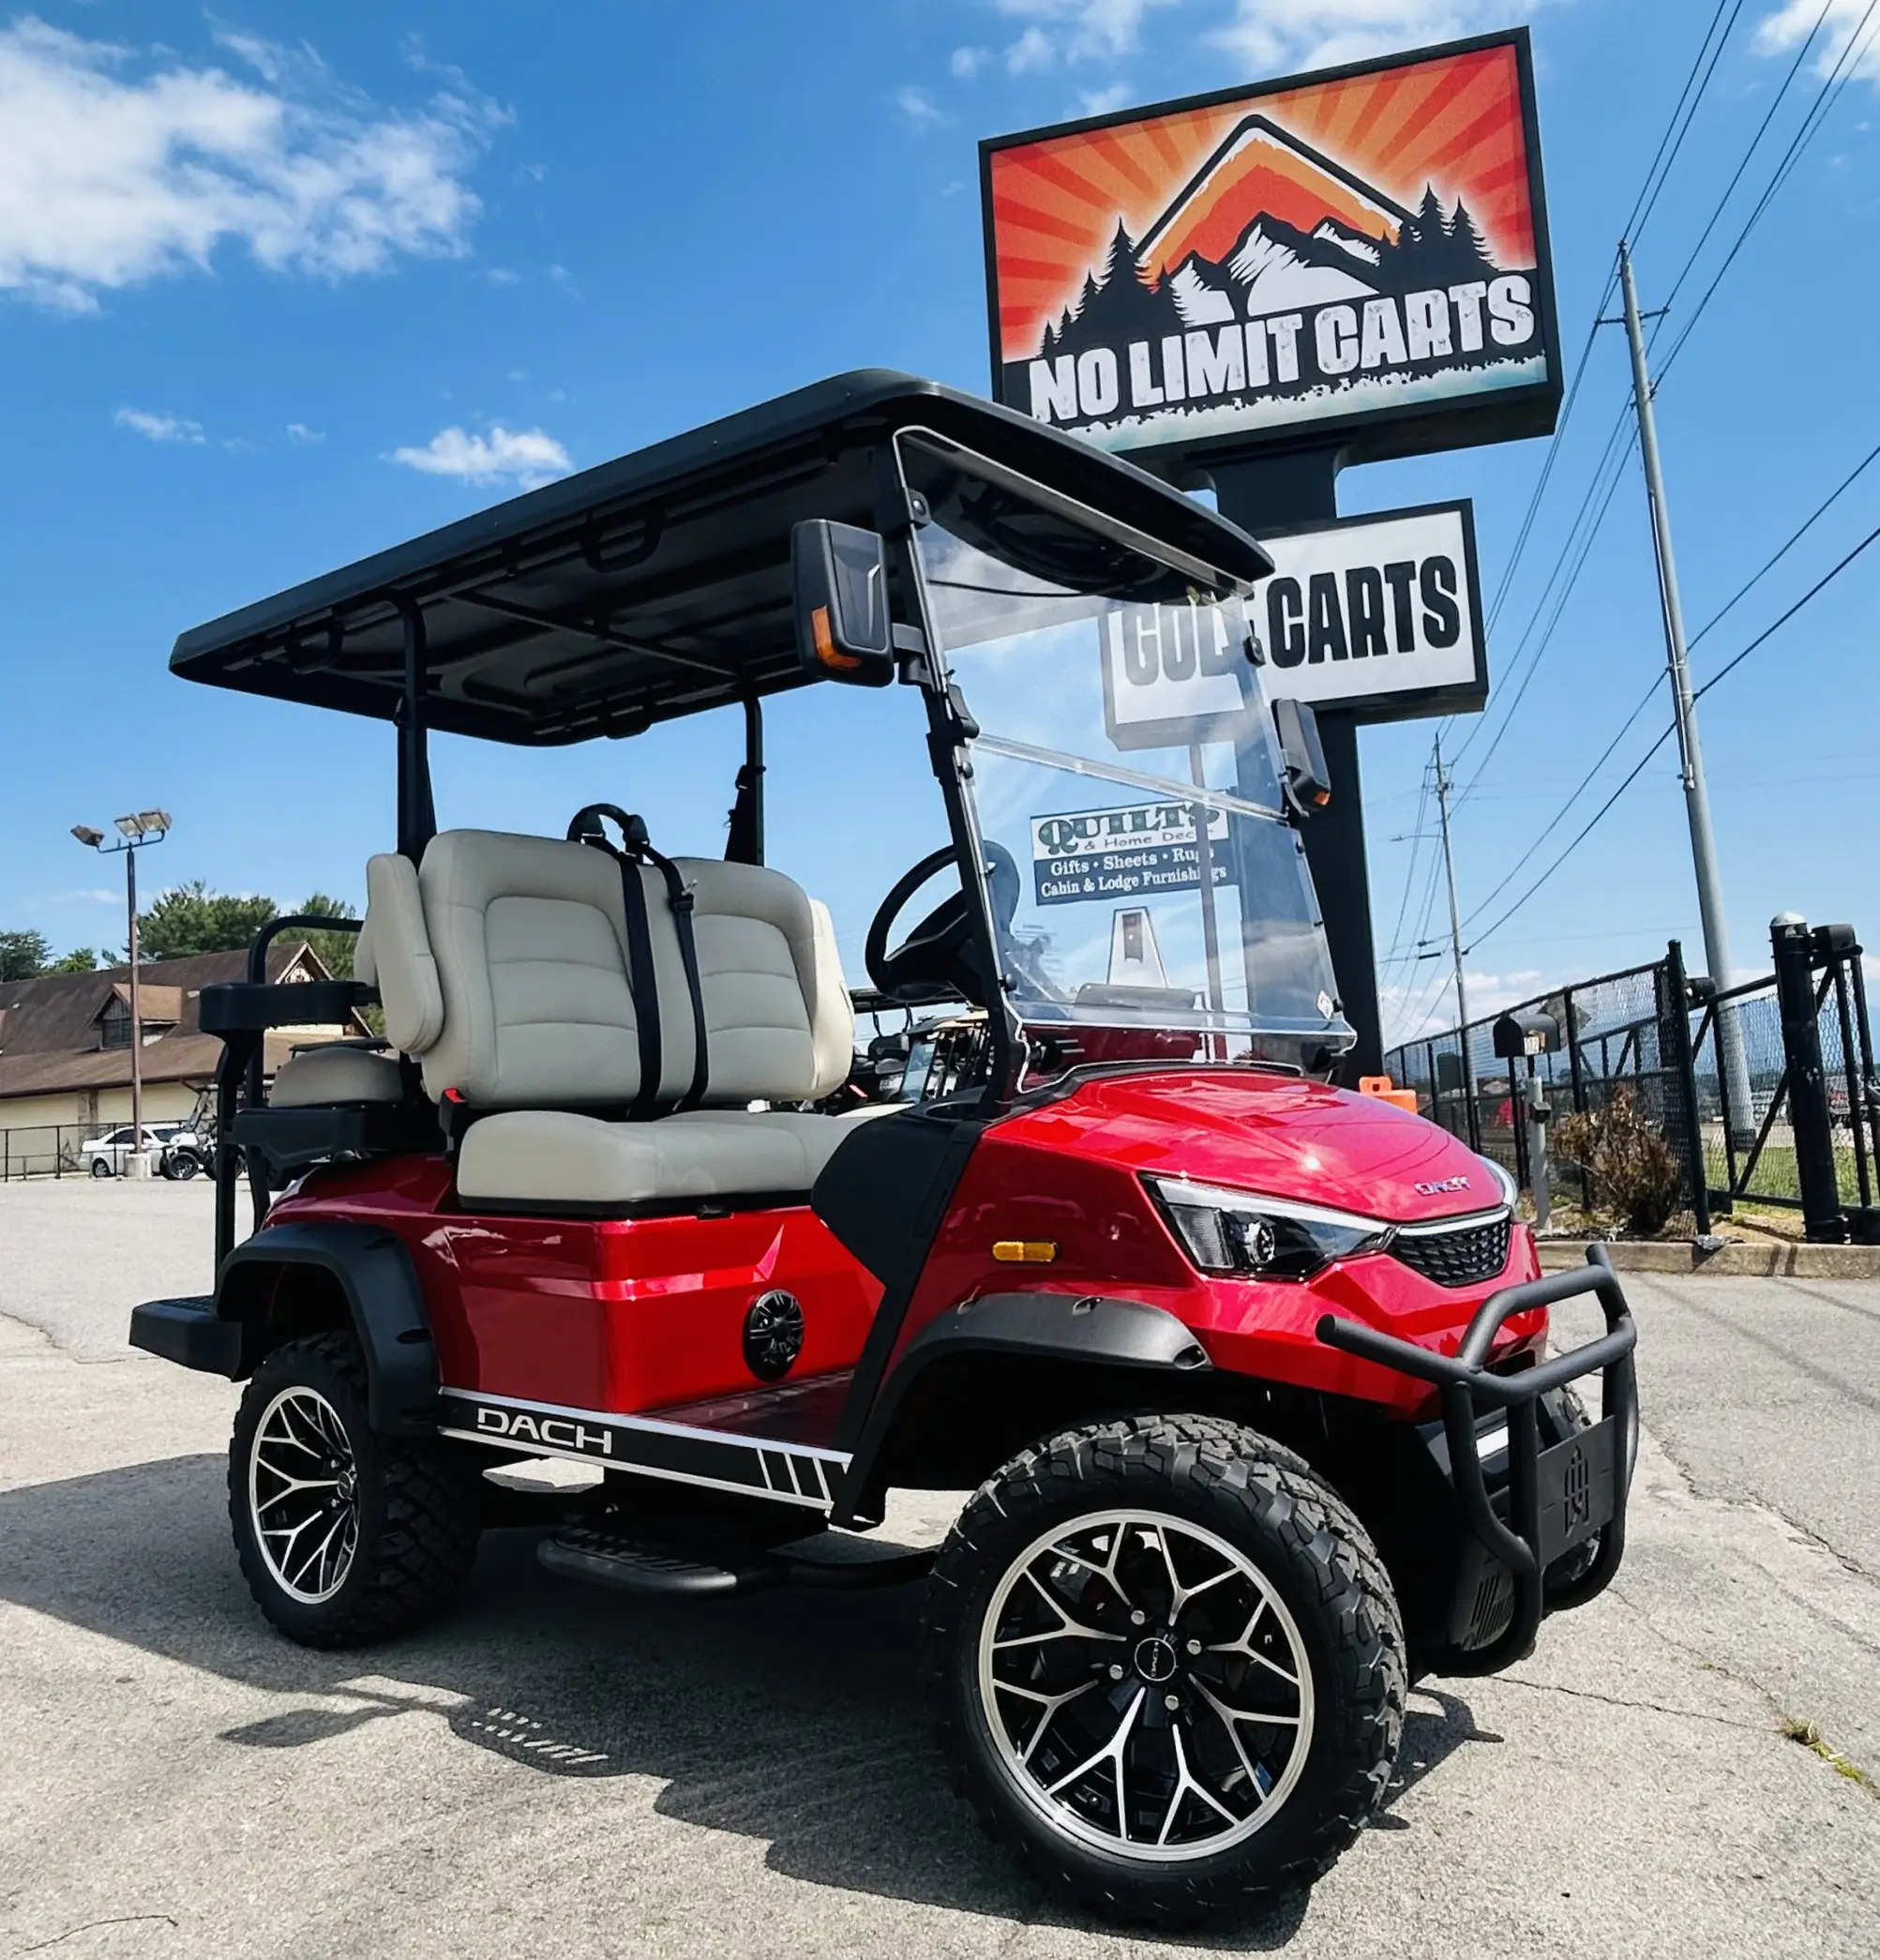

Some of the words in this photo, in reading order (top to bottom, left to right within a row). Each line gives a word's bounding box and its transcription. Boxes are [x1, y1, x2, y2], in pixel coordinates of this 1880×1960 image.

[1030, 349, 1120, 425] NO
[1128, 312, 1304, 408] LIMIT
[1315, 275, 1536, 374] CARTS
[1266, 555, 1461, 669] CARTS
[1105, 836, 1152, 849] Home
[1163, 829, 1214, 842] Dec
[1041, 881, 1080, 897] Cabin
[1083, 878, 1095, 892] &
[1098, 874, 1139, 892] Lodge
[1142, 867, 1227, 886] Furnishigs
[1051, 860, 1090, 876] Gifts
[1104, 852, 1157, 870] Sheets
[477, 1407, 612, 1455] DACH
